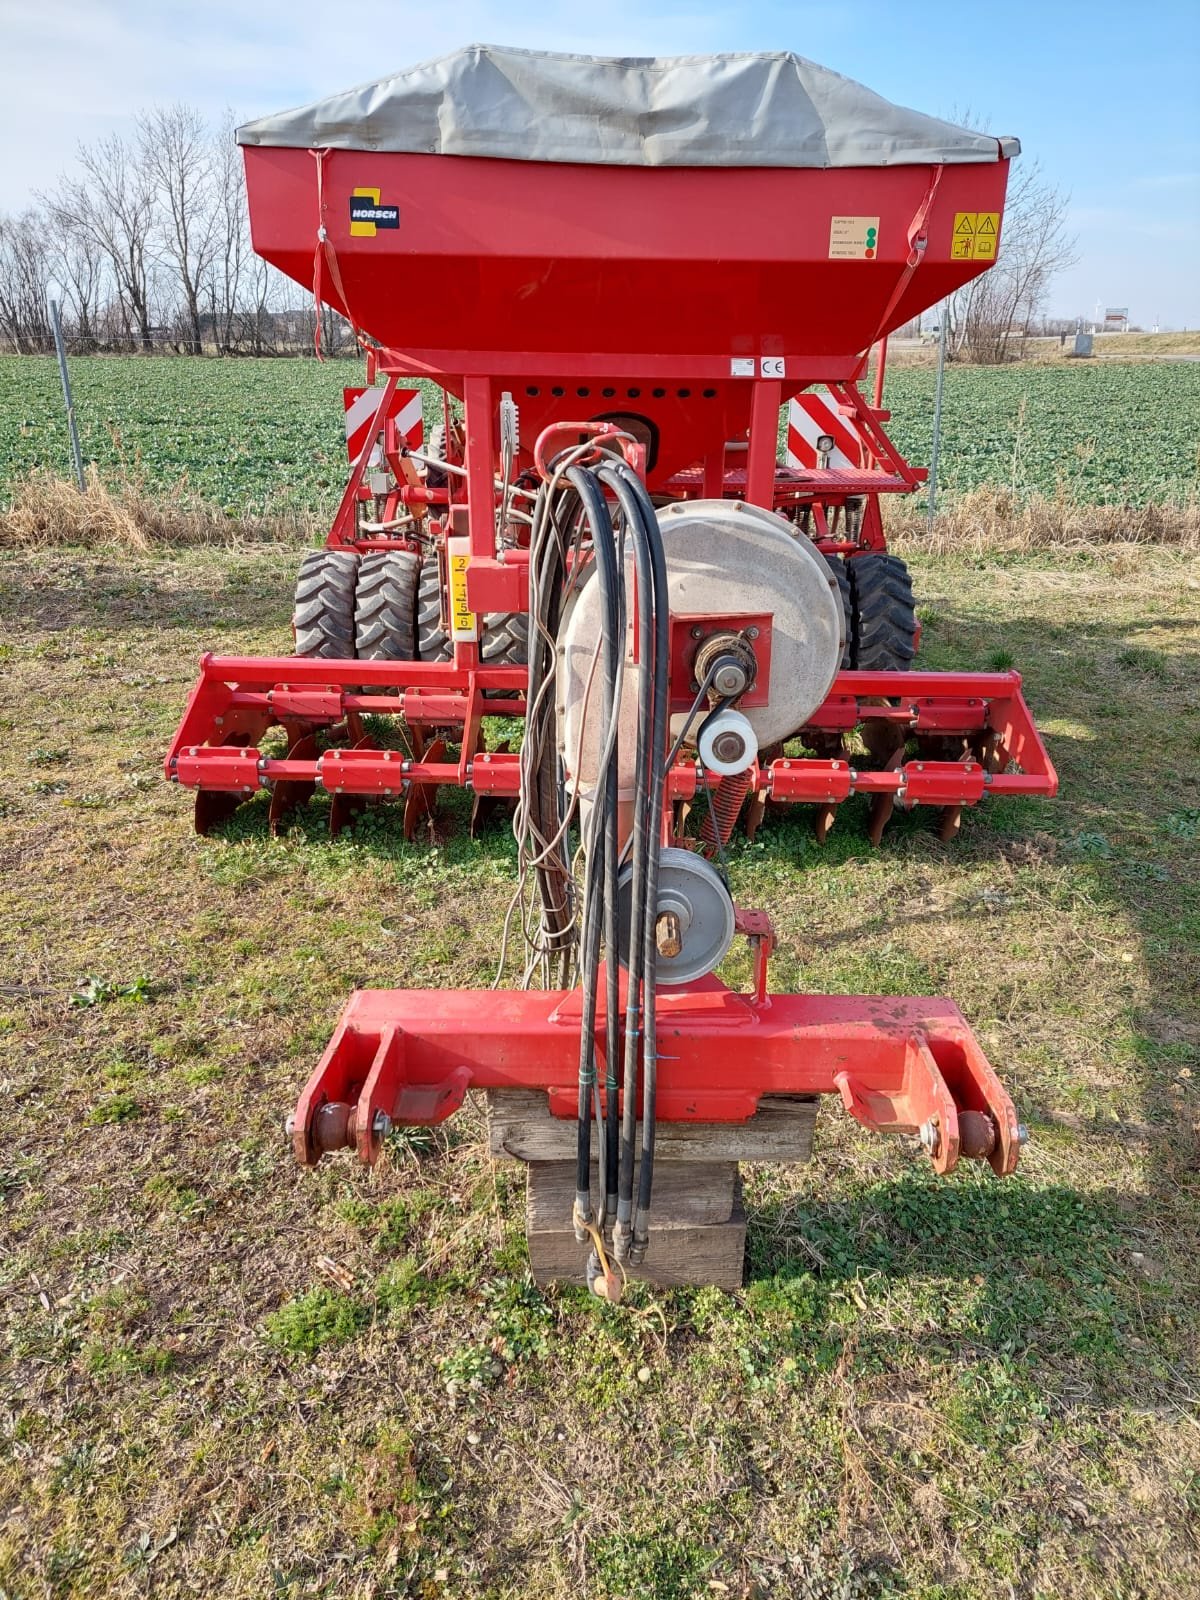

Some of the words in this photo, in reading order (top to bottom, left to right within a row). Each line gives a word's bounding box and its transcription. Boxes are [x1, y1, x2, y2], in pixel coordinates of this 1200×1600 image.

[352, 209, 397, 219] HORSCH
[762, 361, 783, 374] CE
[459, 558, 466, 568] 2
[460, 603, 467, 612] 5
[461, 617, 468, 626] 6
